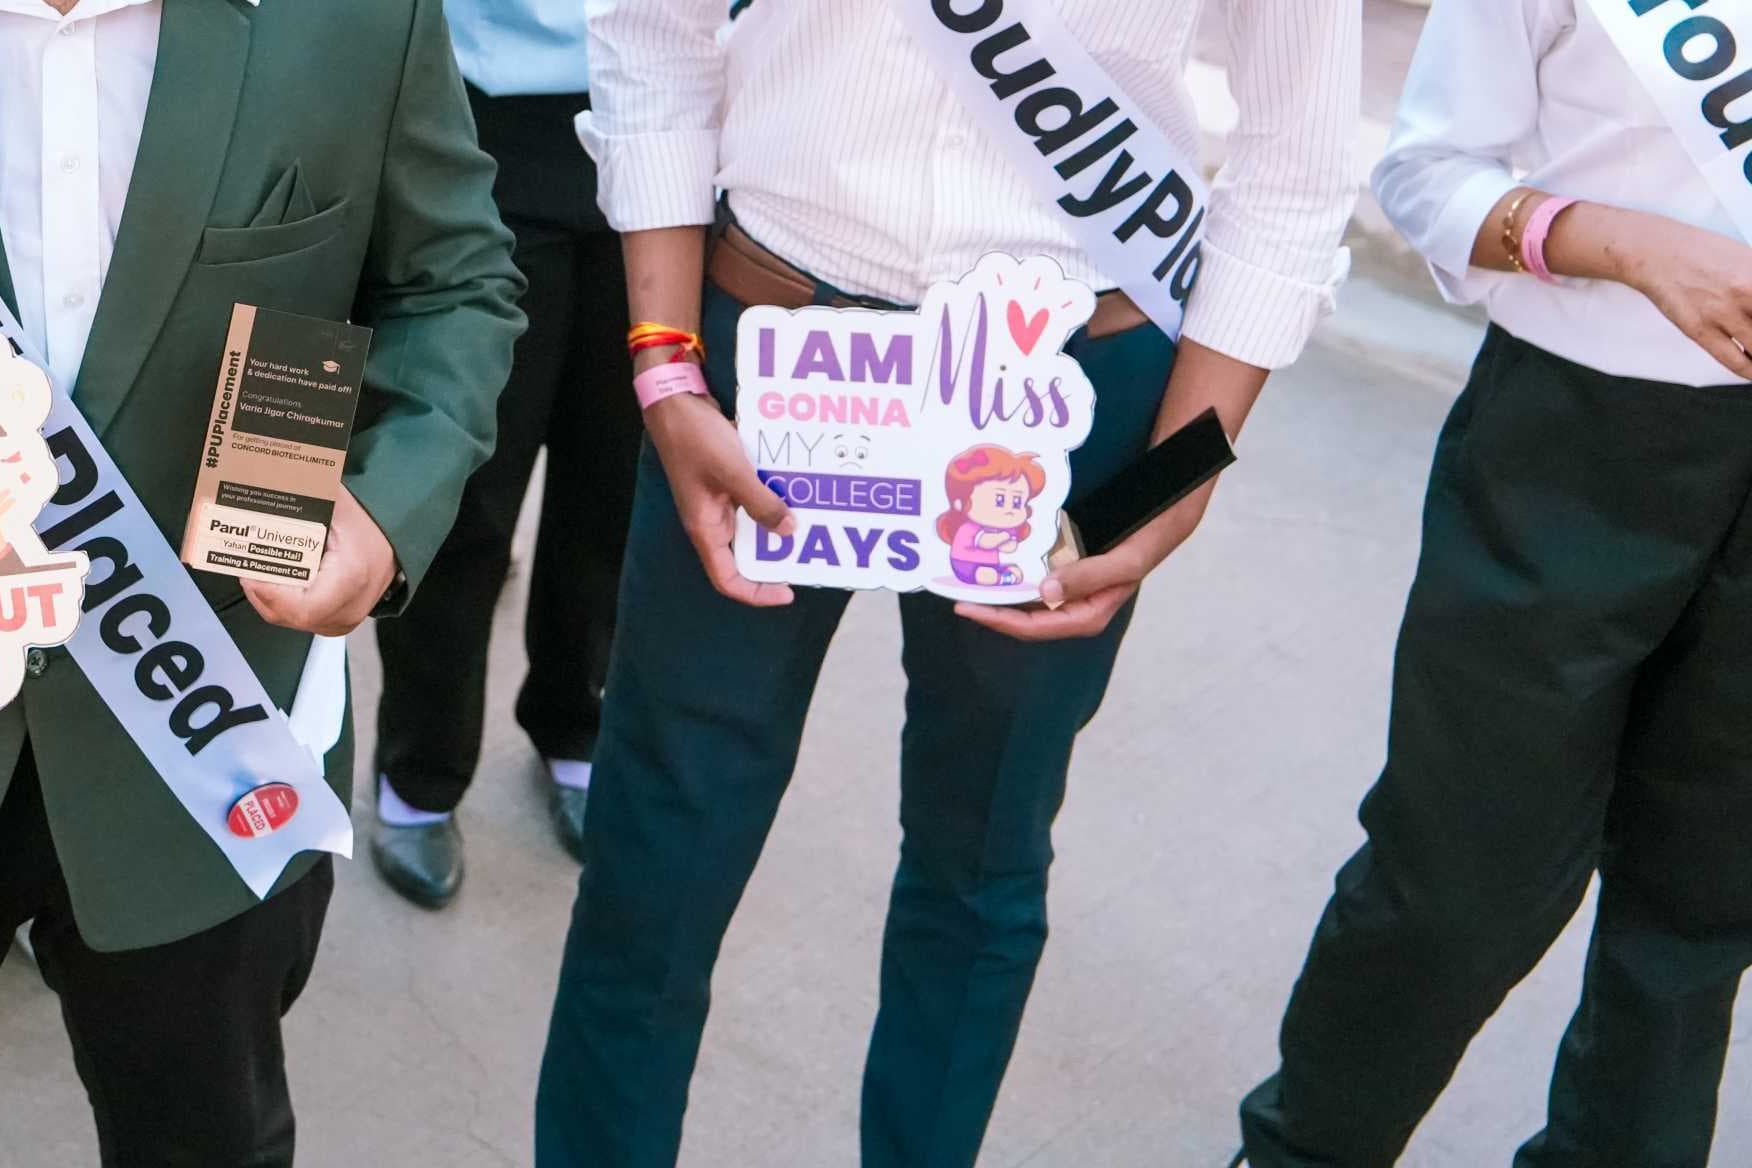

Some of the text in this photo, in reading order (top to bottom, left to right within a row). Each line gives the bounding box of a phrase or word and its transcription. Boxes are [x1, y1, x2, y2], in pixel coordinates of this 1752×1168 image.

[249, 358, 309, 376] Your hard work
[758, 328, 914, 386] I AM
[920, 291, 1072, 431] Miss
[254, 370, 298, 385] dedication
[298, 378, 317, 388] have
[318, 381, 337, 392] paid
[337, 385, 352, 395] off!
[205, 350, 241, 468] #PUPlacement
[242, 390, 302, 408] Congratulations
[757, 391, 912, 428] GONNA
[239, 402, 345, 429] Varia Jigar Chiragkumar
[231, 441, 336, 467] CONCORD BIOTECH LIMITED
[758, 429, 825, 467] MY
[766, 475, 914, 512] COLLEGE
[223, 539, 247, 551] Yahan
[250, 545, 283, 559] Possible
[257, 527, 320, 552] University
[755, 524, 922, 572] DAYS
[210, 553, 242, 567] Training
[249, 561, 290, 576] Placement
[291, 567, 307, 578] Cell
[244, 800, 265, 831] PLACED
